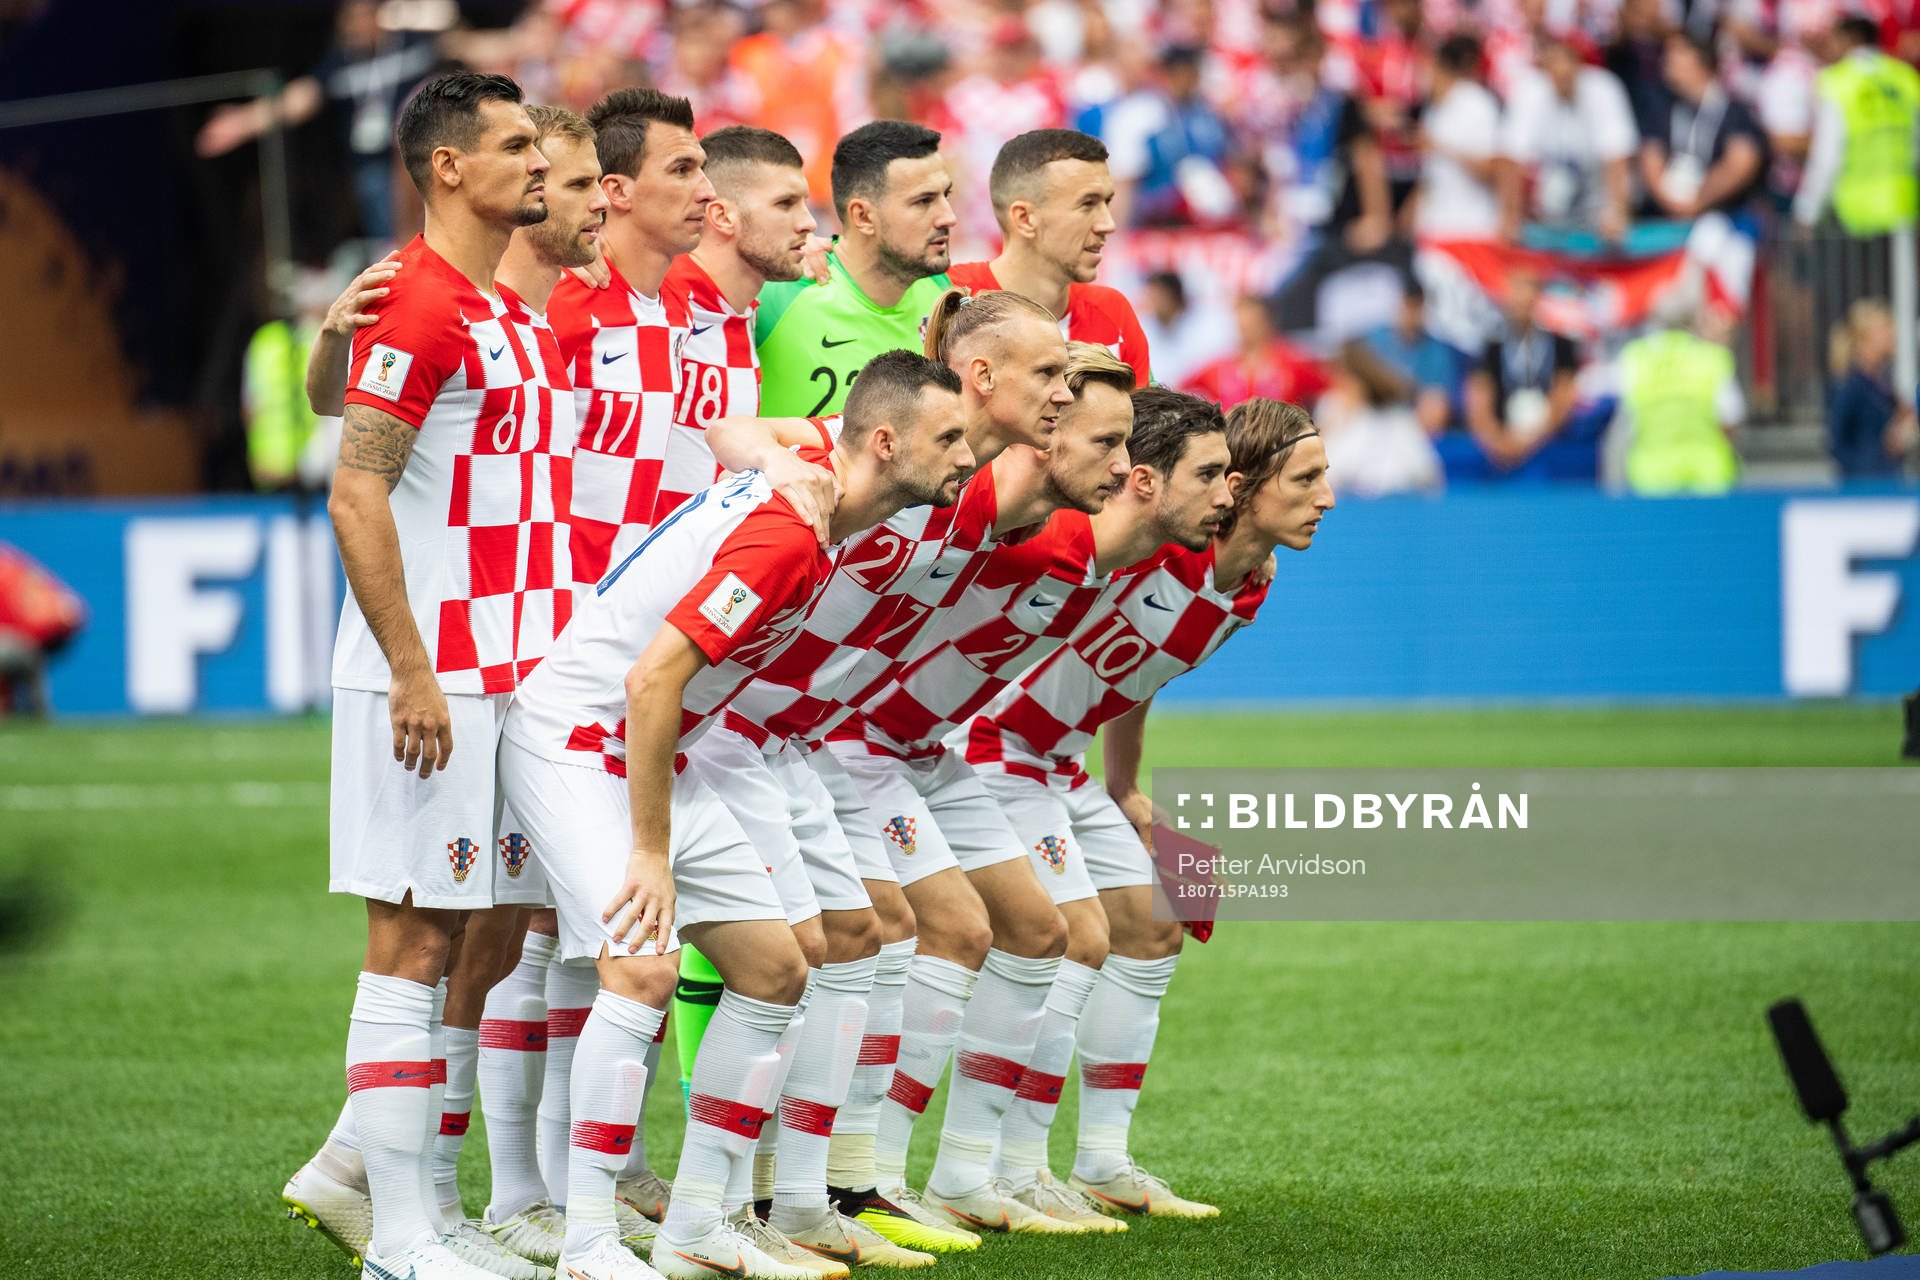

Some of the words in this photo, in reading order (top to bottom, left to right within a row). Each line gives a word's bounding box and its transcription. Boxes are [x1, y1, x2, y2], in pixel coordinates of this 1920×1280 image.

[492, 389, 517, 453] 6
[677, 361, 722, 428] 18
[807, 366, 859, 418] 2
[591, 392, 640, 454] 17
[841, 534, 915, 594] 21
[874, 603, 929, 645] 7
[965, 634, 1027, 669] 2
[1081, 615, 1147, 678] 10
